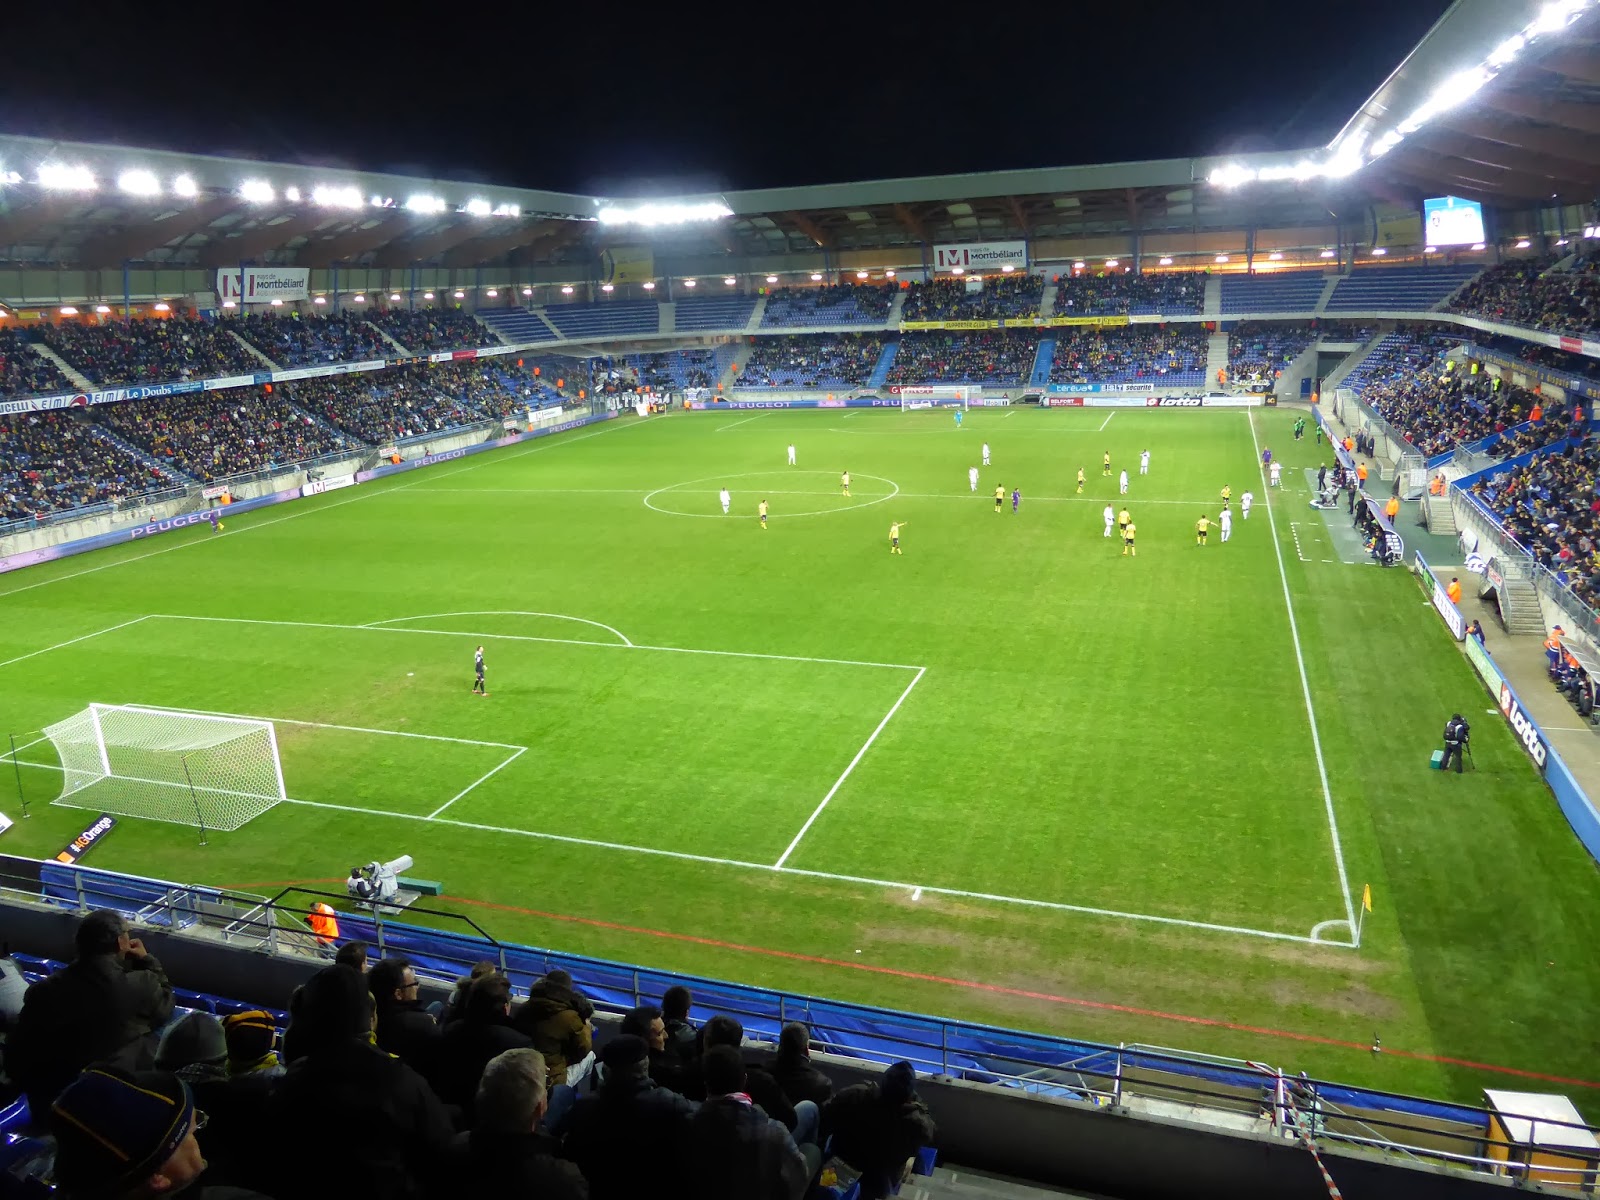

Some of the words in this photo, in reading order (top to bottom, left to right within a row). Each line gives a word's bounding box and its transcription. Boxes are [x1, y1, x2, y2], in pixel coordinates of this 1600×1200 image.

[971, 250, 1022, 260] Montbéliard
[257, 278, 304, 288] Montbéliard
[126, 391, 138, 399] Le
[141, 387, 171, 397] Doubs
[1160, 397, 1200, 406] lotto
[549, 420, 586, 434] PEUGEOT
[414, 449, 466, 467] PEUGEOT
[131, 508, 224, 538] PEUGEOT
[1509, 700, 1546, 767] lotto
